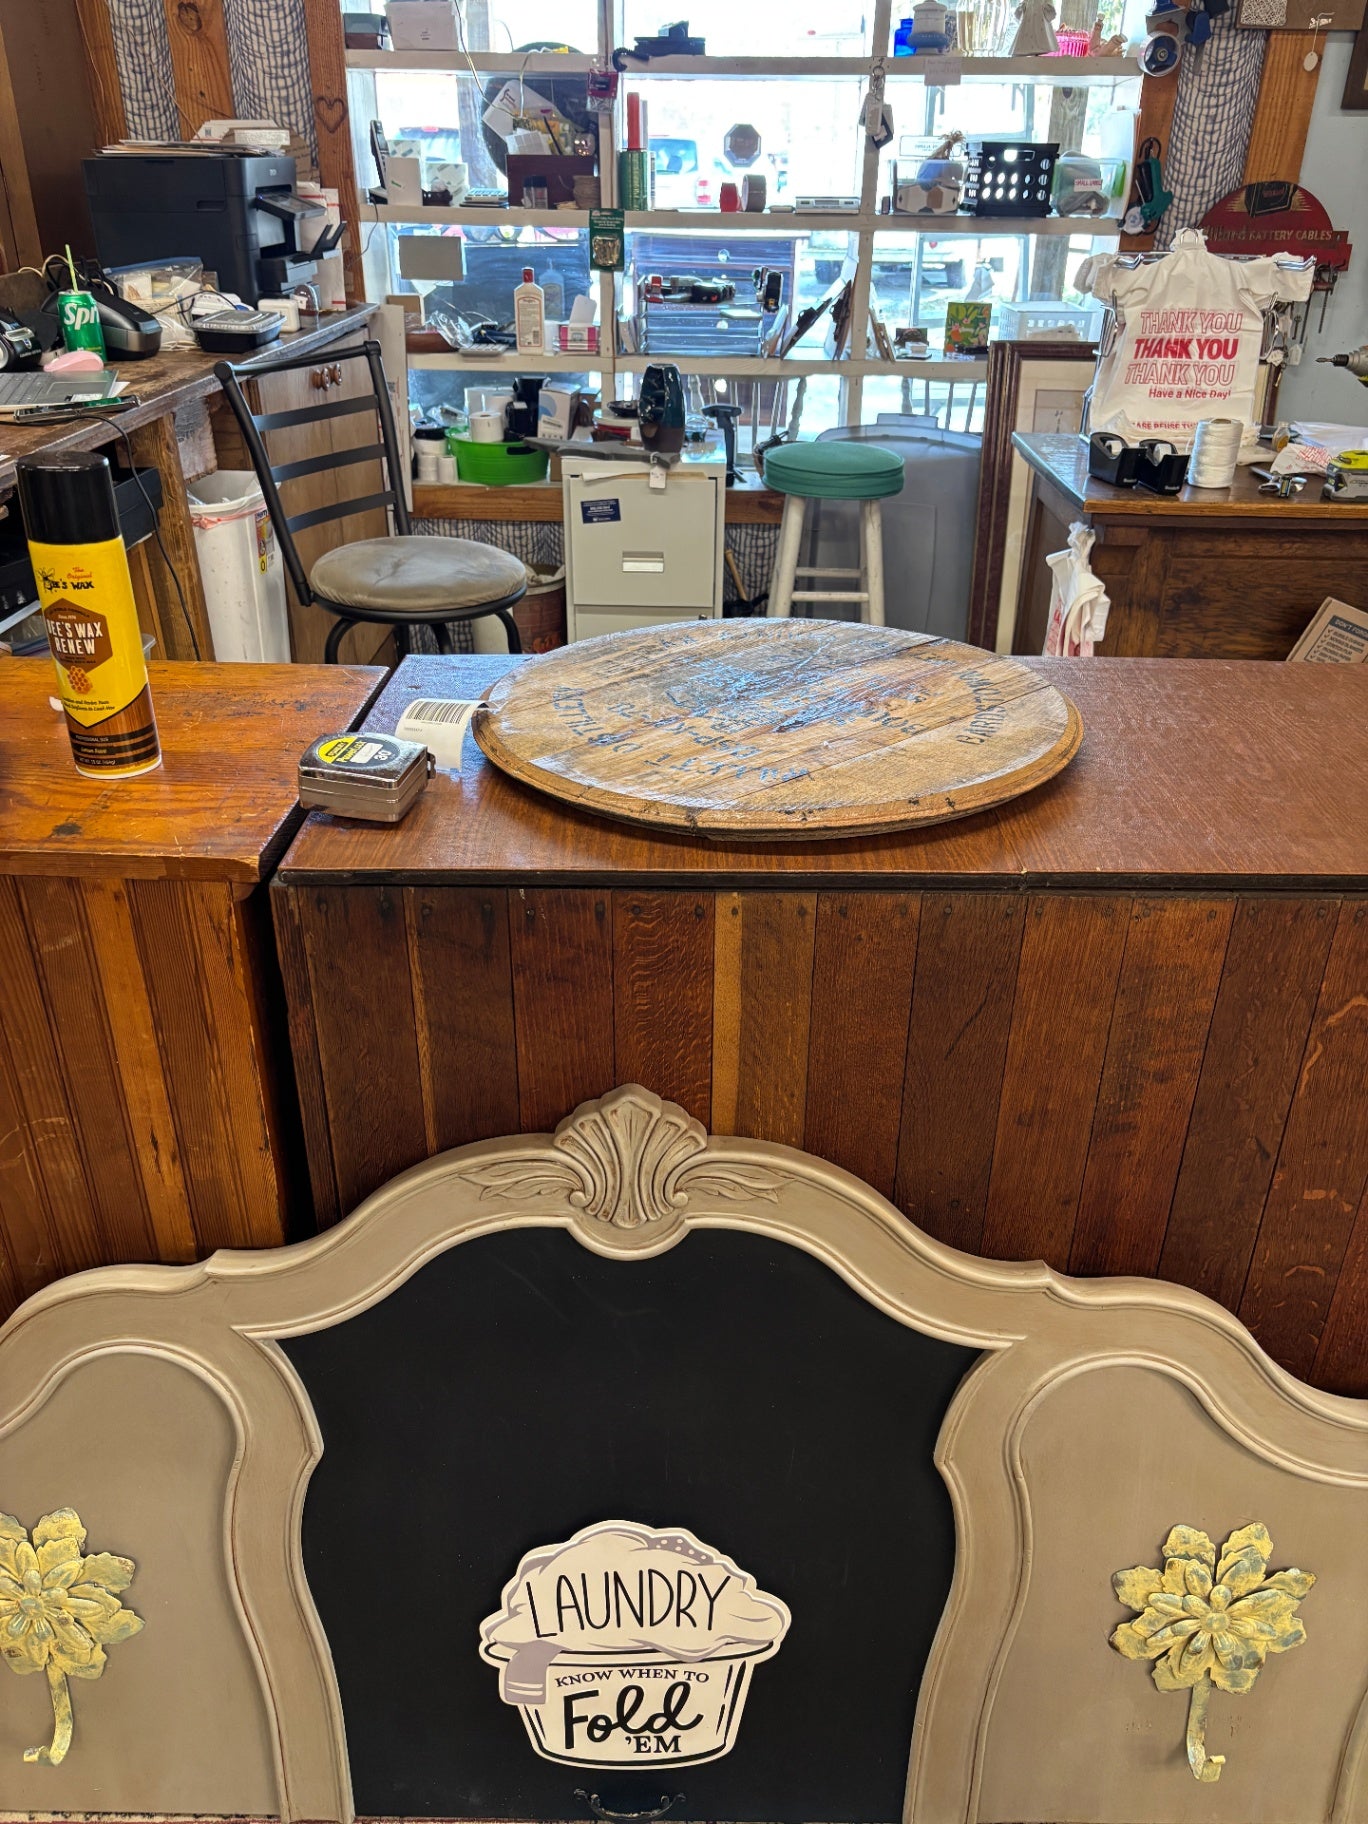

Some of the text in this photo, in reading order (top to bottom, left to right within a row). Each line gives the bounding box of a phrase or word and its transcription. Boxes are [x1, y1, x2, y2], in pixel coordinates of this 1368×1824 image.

[1295, 229, 1333, 241] CABLES
[1140, 311, 1243, 335] THANK YOU
[1133, 338, 1239, 360] THANK YOU
[1124, 362, 1235, 386] THANK YOU
[1148, 388, 1231, 400] Have a Nice Day!
[74, 621, 103, 638] WAX
[54, 636, 95, 655] RENEW
[374, 750, 392, 761] 30
[526, 1568, 732, 1638] LAUNDRY
[555, 1668, 710, 1687] KNOW WHEN TO
[563, 1681, 704, 1750] Fold
[625, 1735, 683, 1753] 'EM
